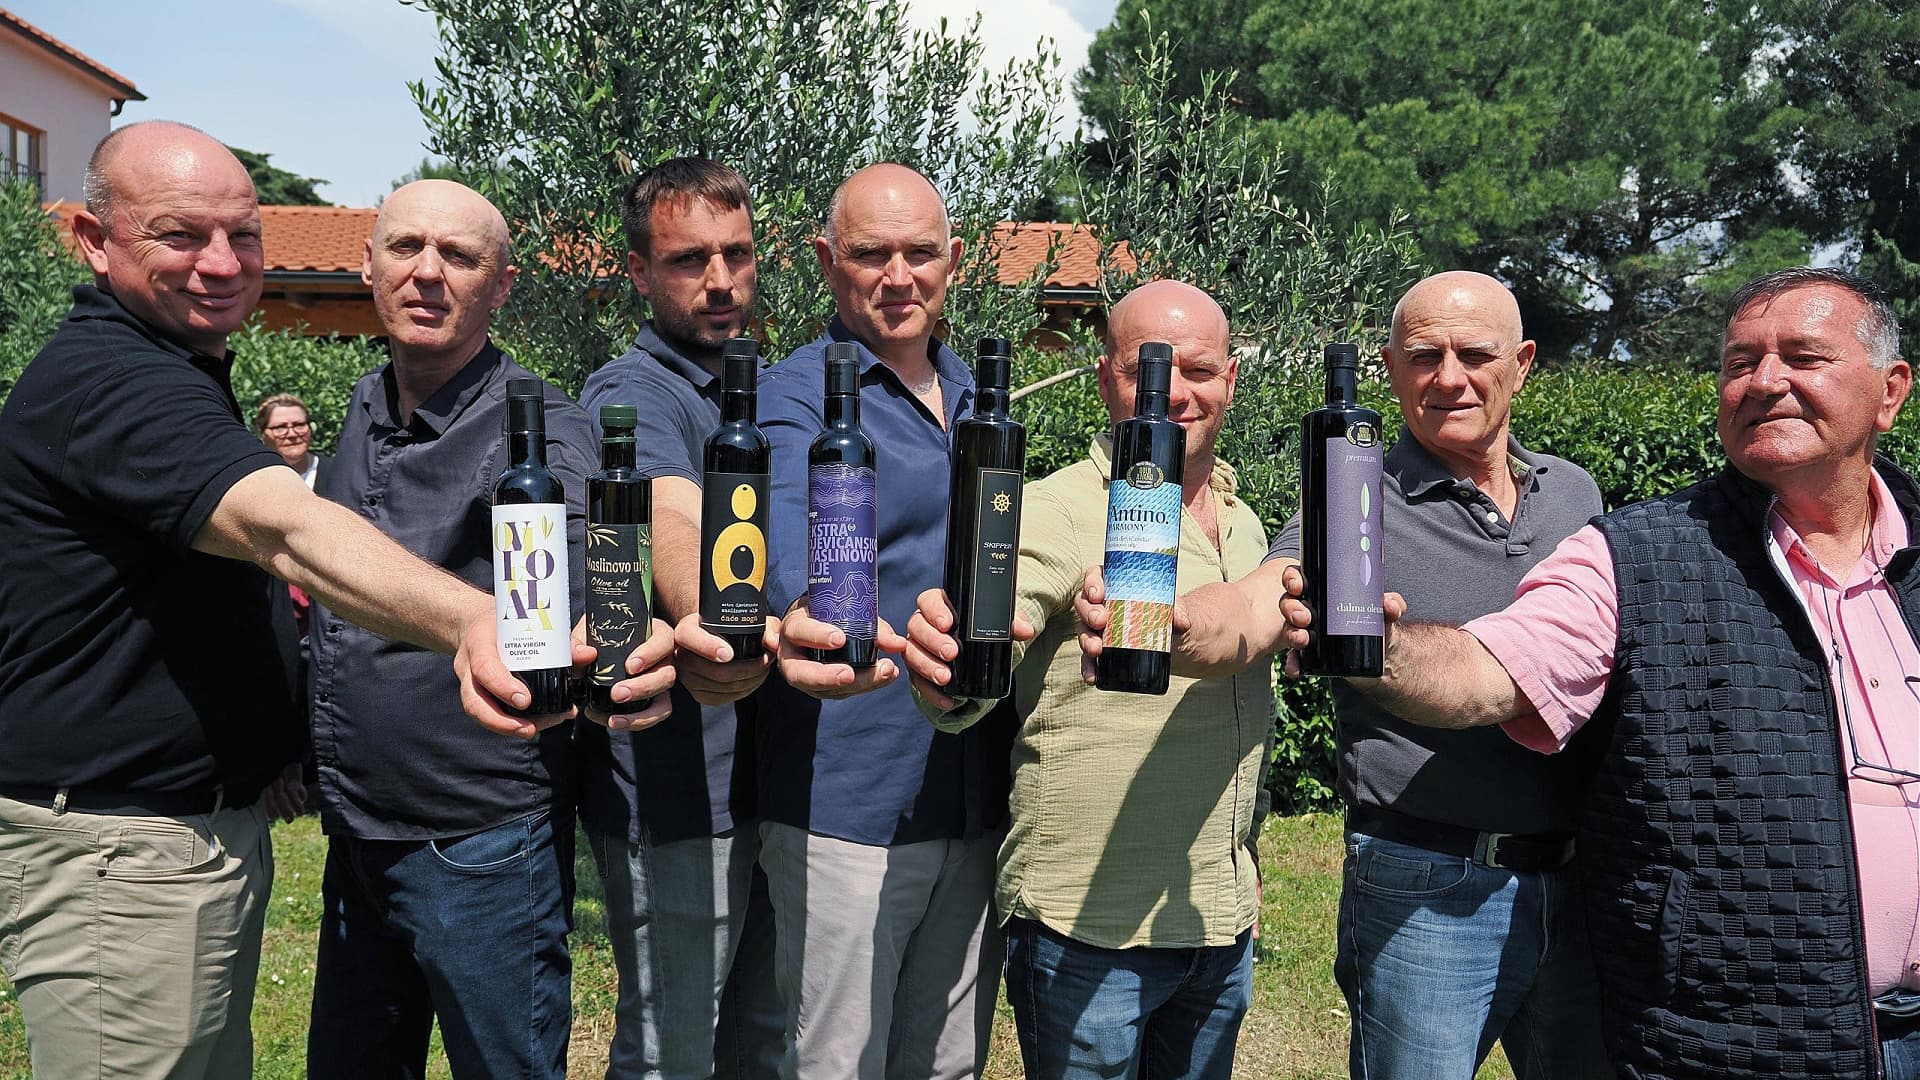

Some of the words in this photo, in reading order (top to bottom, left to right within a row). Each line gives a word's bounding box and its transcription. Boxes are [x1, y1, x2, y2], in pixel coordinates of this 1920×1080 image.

[1111, 504, 1169, 525] Antino.
[983, 541, 1013, 550] SKIPPER
[633, 557, 649, 575] ulje
[591, 576, 613, 588] Olive
[615, 578, 630, 588] oil
[1336, 602, 1365, 613] dalma
